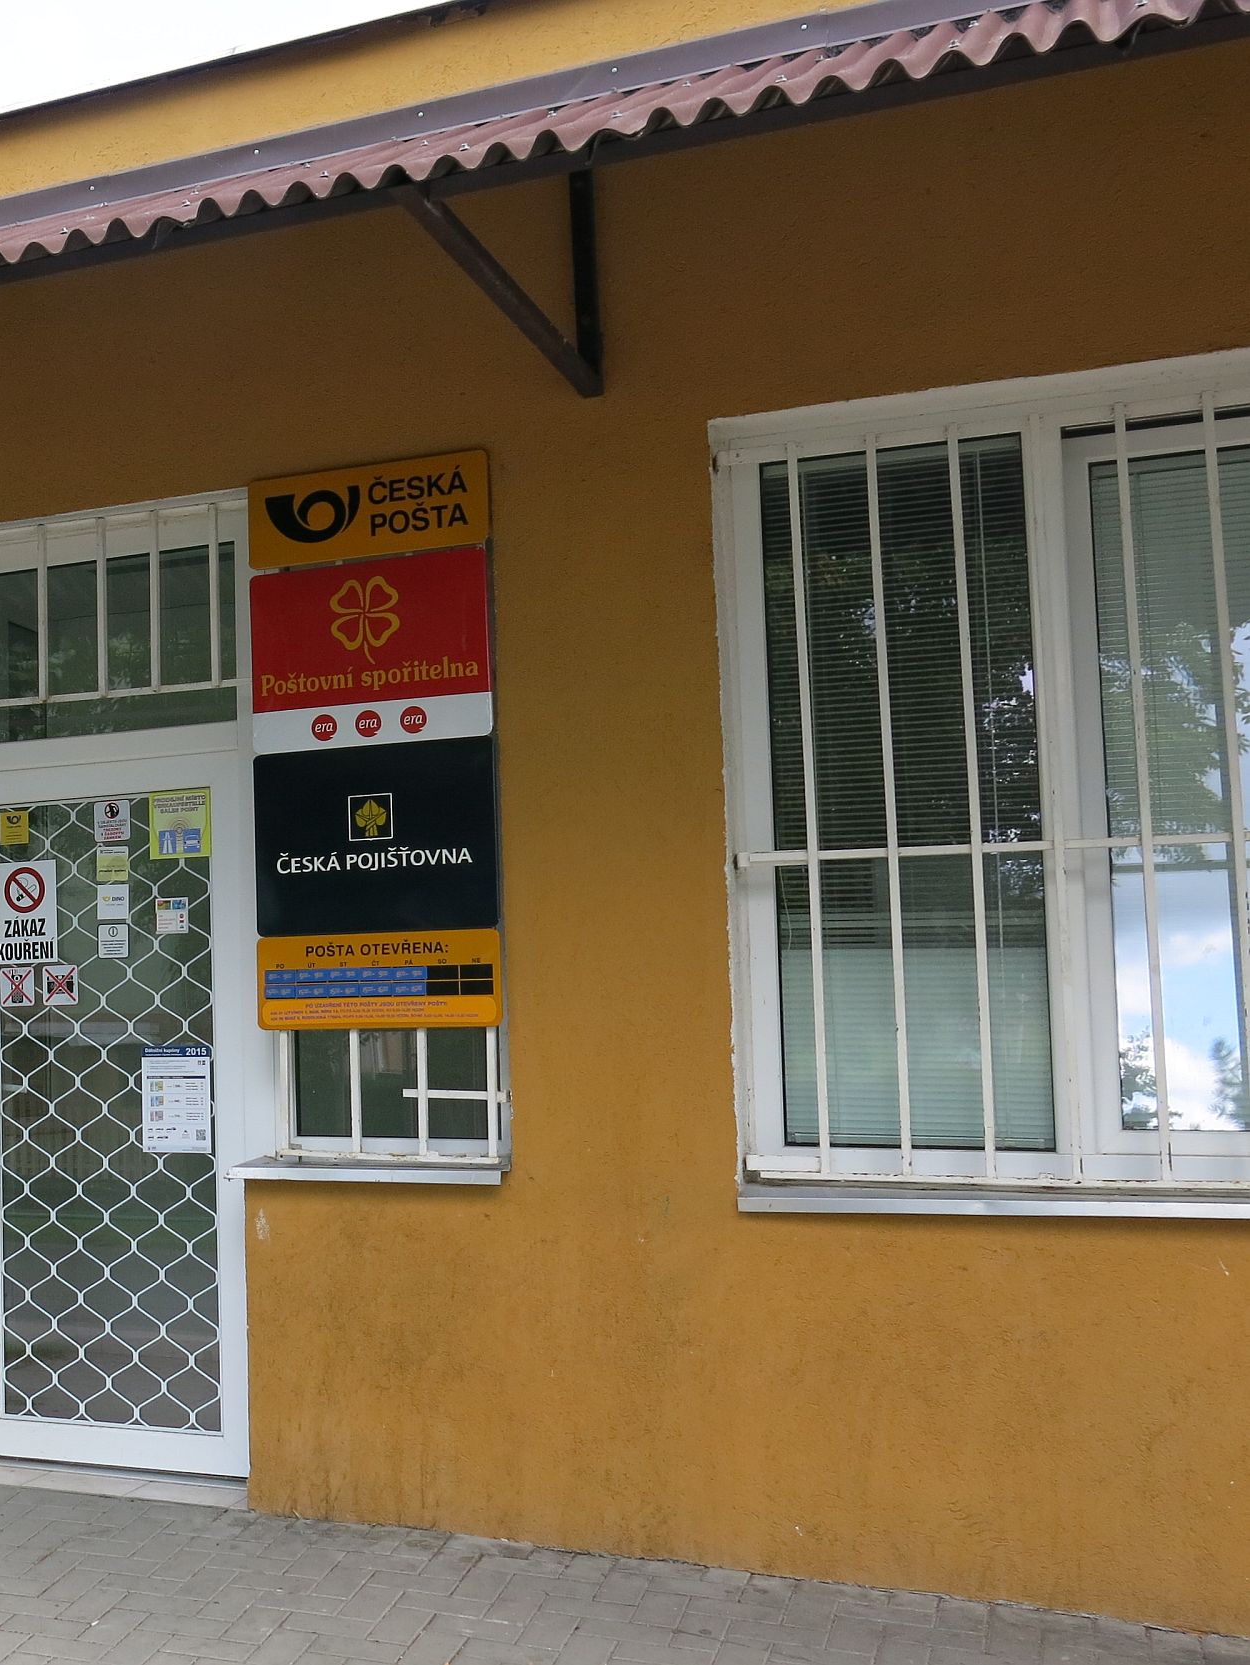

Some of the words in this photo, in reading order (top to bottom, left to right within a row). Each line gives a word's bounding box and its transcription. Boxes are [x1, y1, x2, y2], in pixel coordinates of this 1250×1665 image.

[367, 465, 468, 505] ČESKÁ
[369, 502, 469, 537] POŠTA
[261, 666, 354, 697] Poštovní
[360, 656, 479, 691] spořitelna
[314, 721, 334, 733] era
[358, 717, 378, 729] era
[403, 713, 423, 725] era
[276, 852, 341, 875] ČESKÁ
[345, 847, 473, 871] POJIŠŤOVNA
[4, 915, 46, 938] ZÁKAZ
[305, 942, 355, 958] POŠTA
[360, 940, 449, 956] OTEVŘENA:
[185, 1047, 207, 1056] 2015
